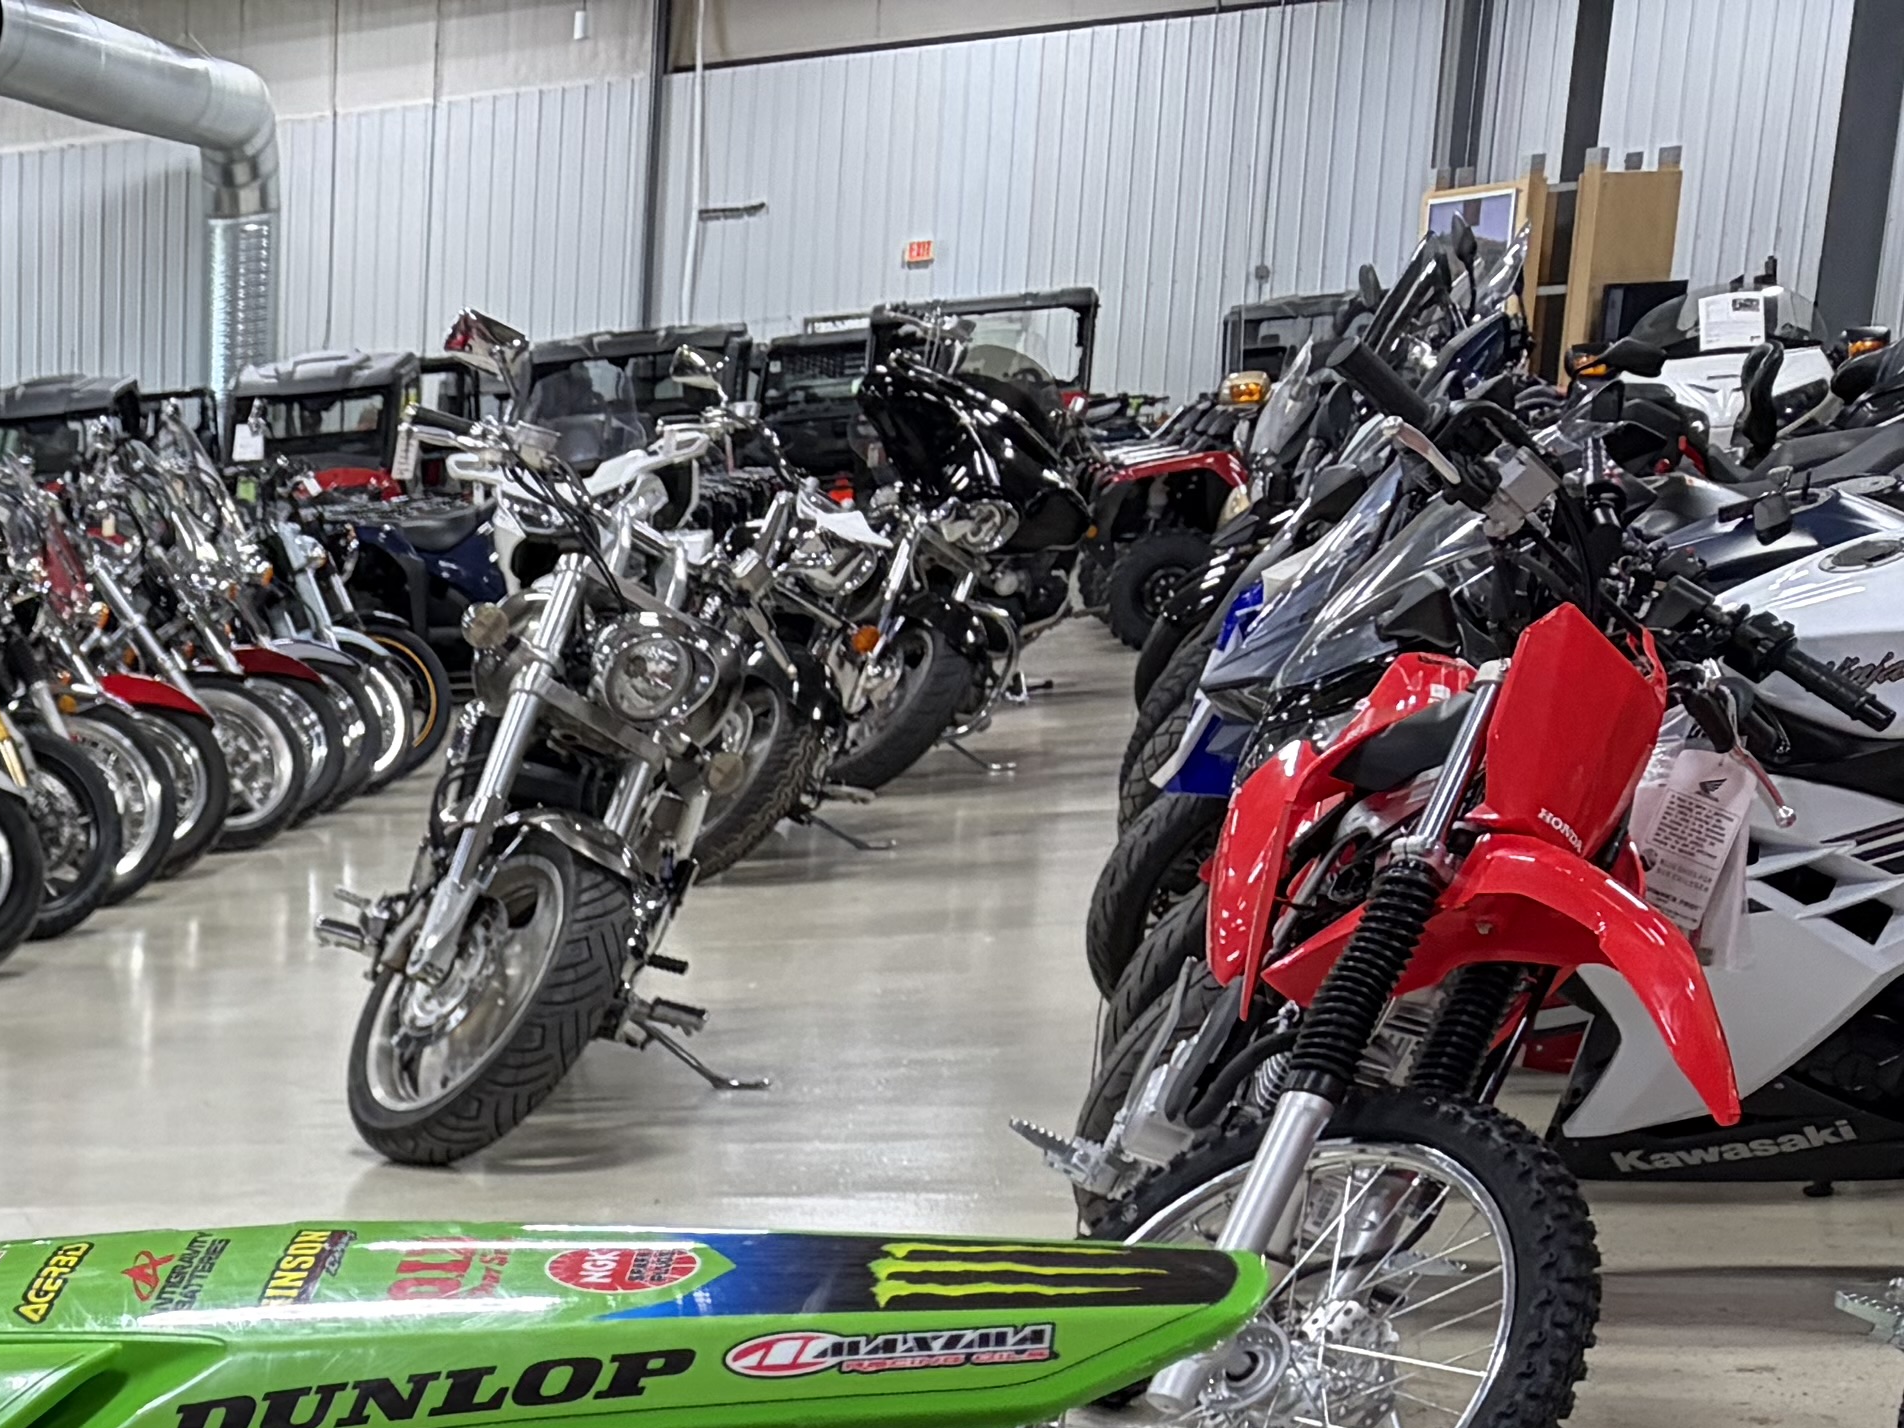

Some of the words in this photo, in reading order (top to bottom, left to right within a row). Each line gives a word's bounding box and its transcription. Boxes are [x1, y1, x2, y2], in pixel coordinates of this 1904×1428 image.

[1537, 807, 1583, 853] HONDA
[1610, 1118, 1858, 1173] Kawasaki
[582, 1249, 621, 1284] NGK
